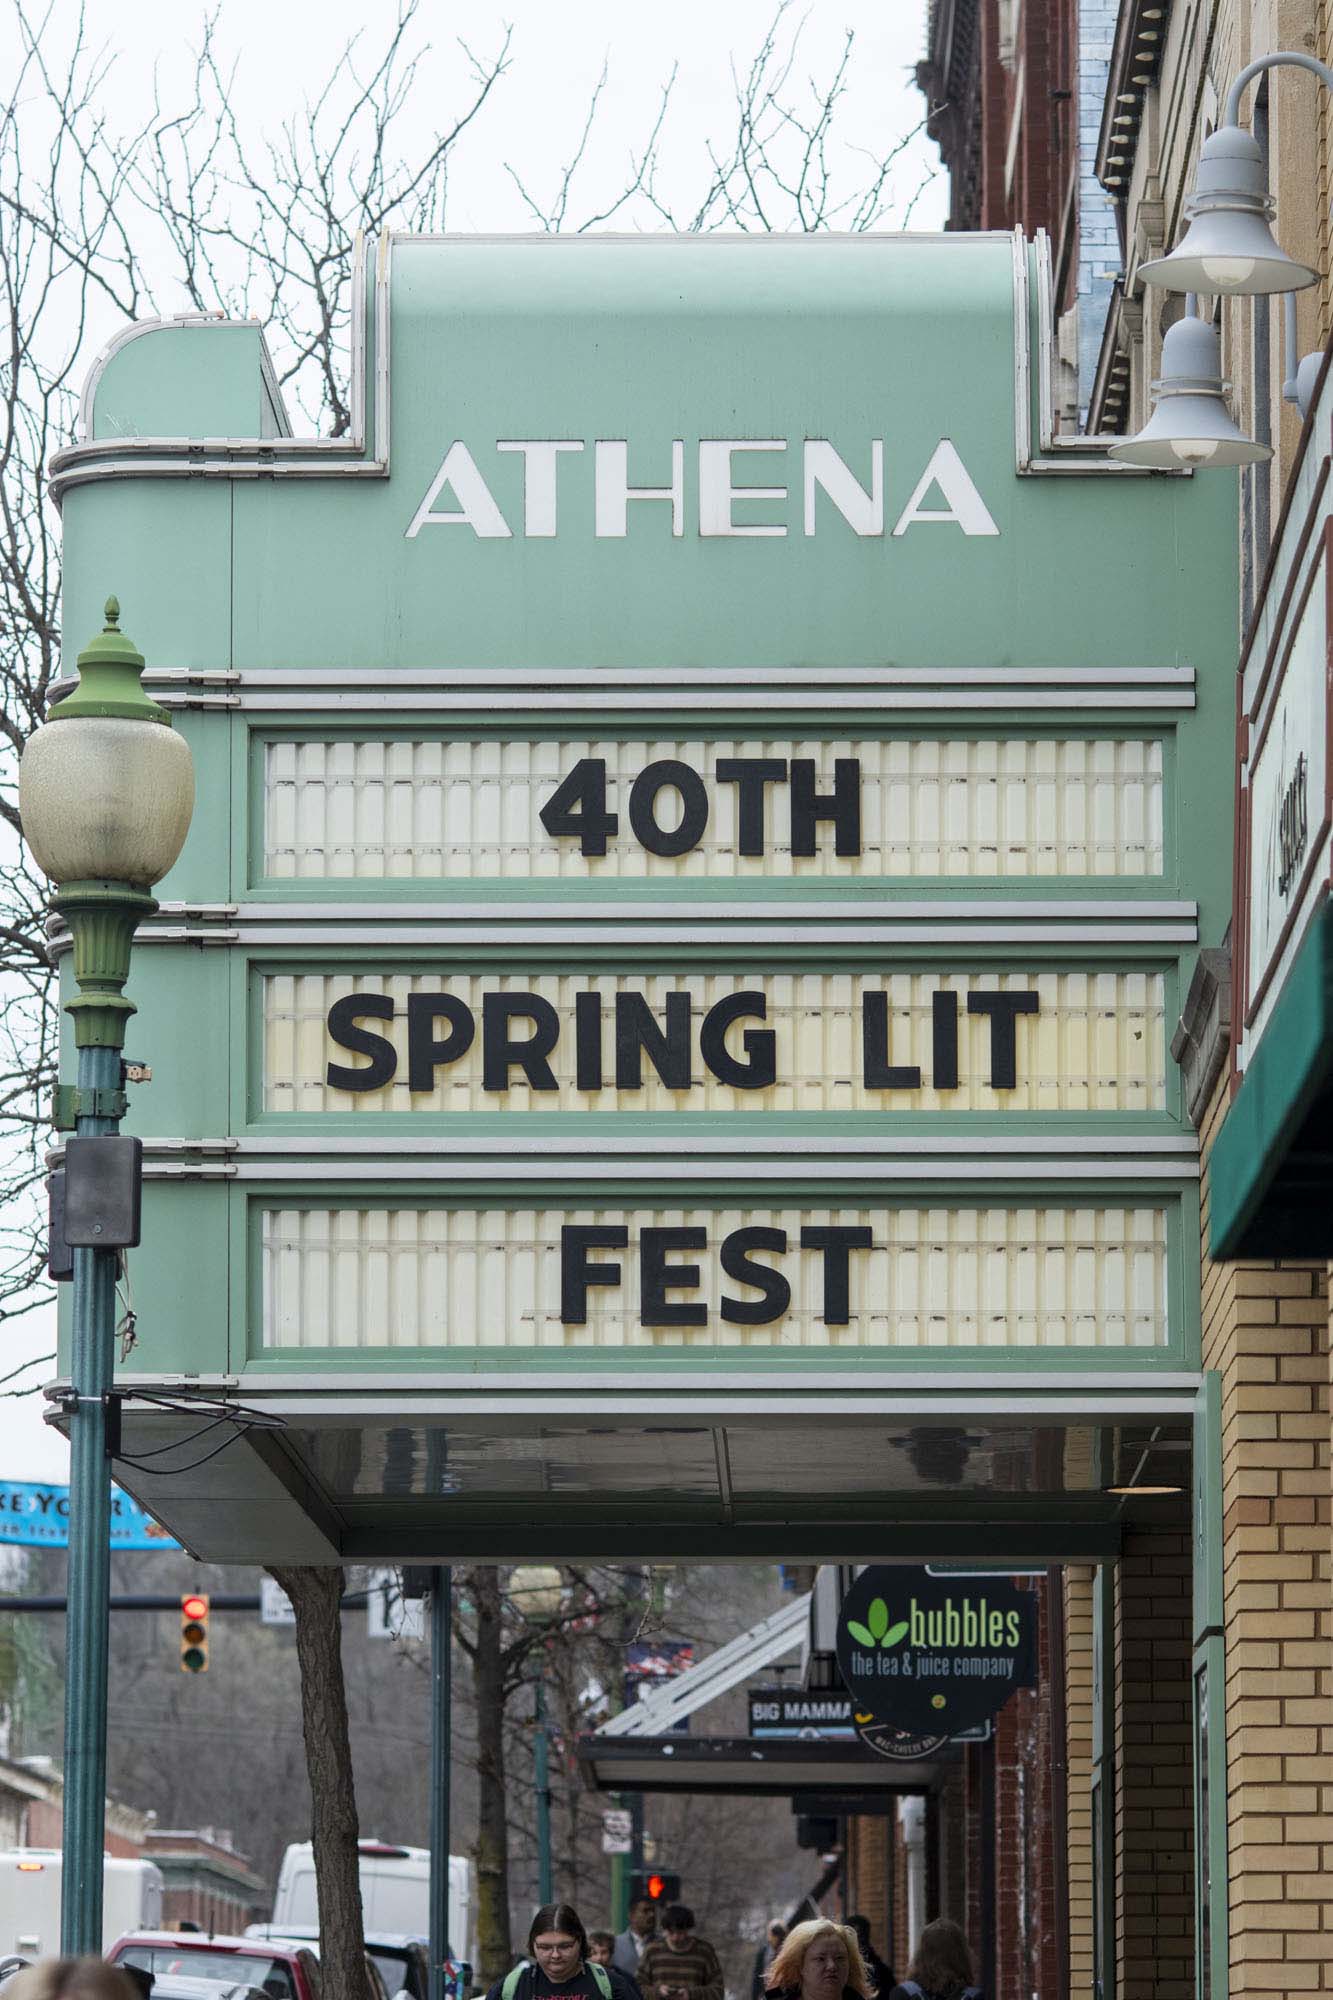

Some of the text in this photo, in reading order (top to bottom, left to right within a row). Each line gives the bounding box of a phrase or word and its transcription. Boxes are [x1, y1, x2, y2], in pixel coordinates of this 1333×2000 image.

[404, 438, 1001, 538] ATHENA
[539, 758, 861, 857] 40TH
[326, 990, 1040, 1092] SPRING LIT
[561, 1225, 873, 1327] FEST
[852, 1652, 1014, 1680] the tea & juice company
[911, 1598, 1020, 1648] bubbles
[752, 1702, 780, 1721] BIG
